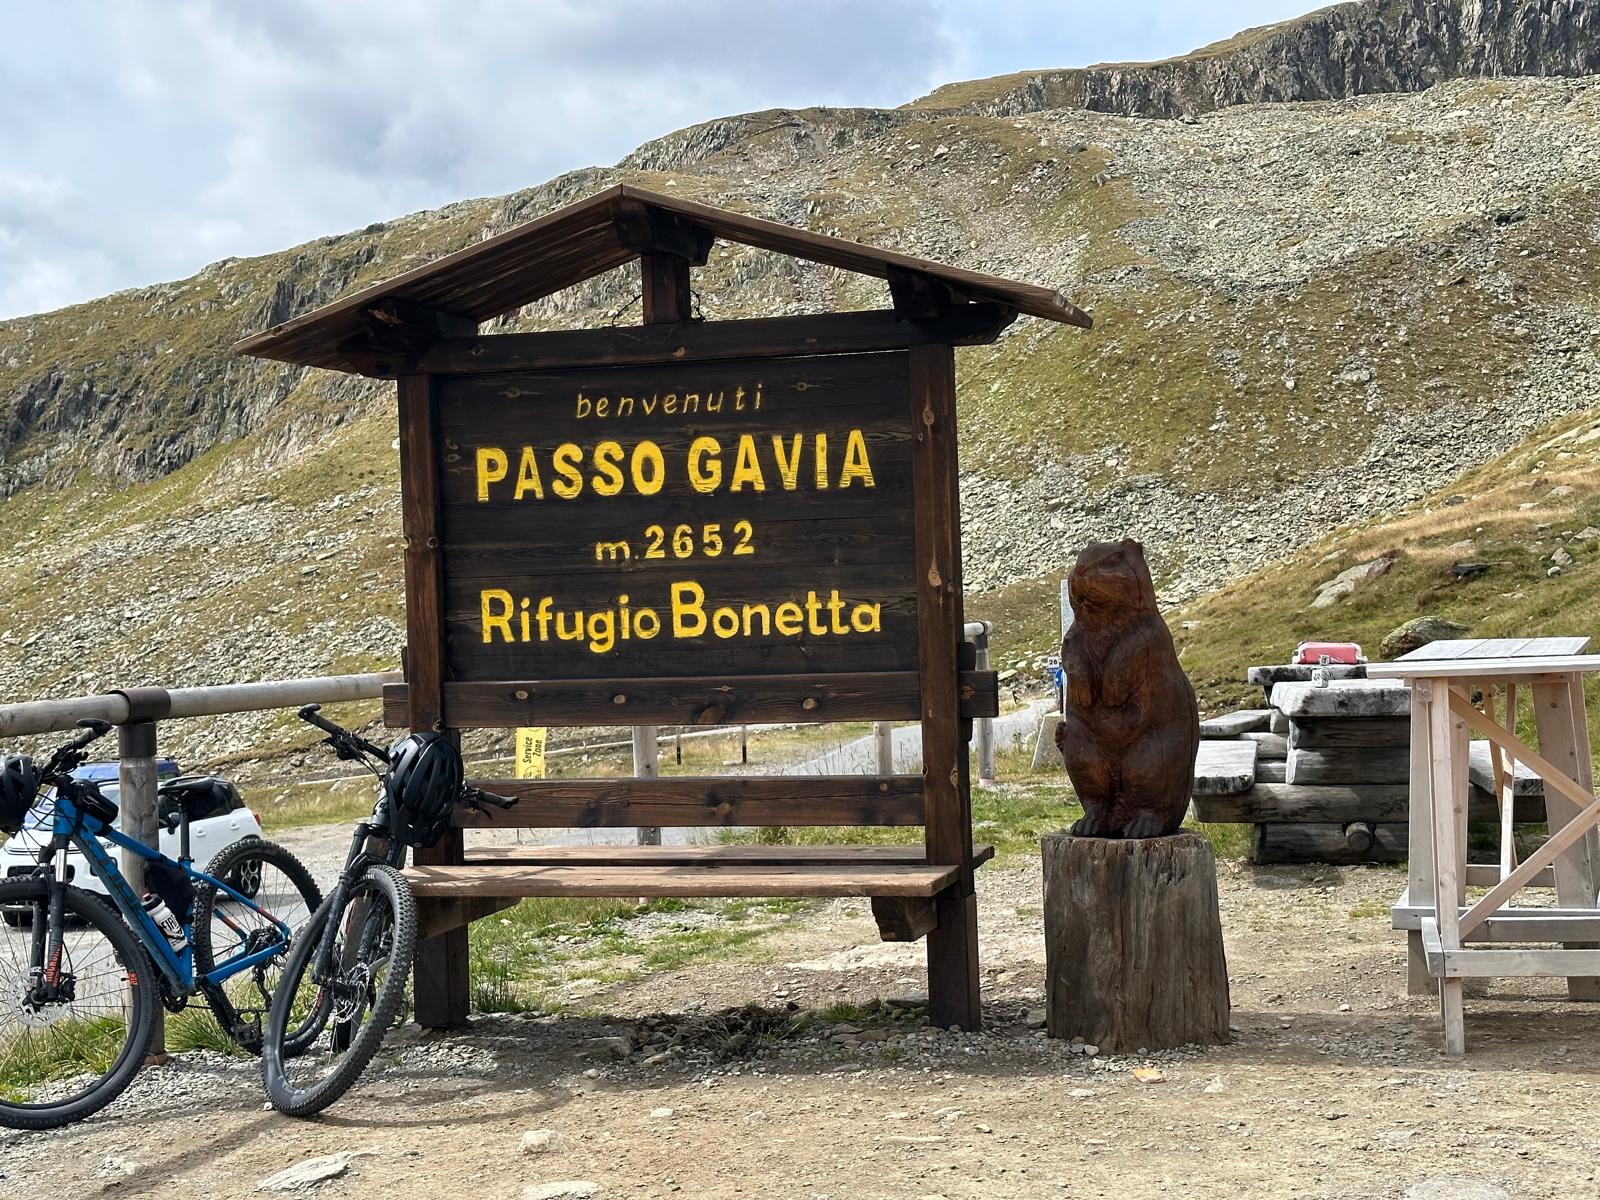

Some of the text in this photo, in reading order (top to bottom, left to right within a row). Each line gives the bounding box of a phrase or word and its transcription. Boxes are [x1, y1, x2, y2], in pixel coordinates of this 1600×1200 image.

[576, 383, 763, 418] benvenuti
[475, 428, 876, 502] PASSO GAVIA
[479, 580, 881, 654] Rifugio Bonetta
[523, 736, 533, 764] Service
[533, 739, 543, 757] Zone
